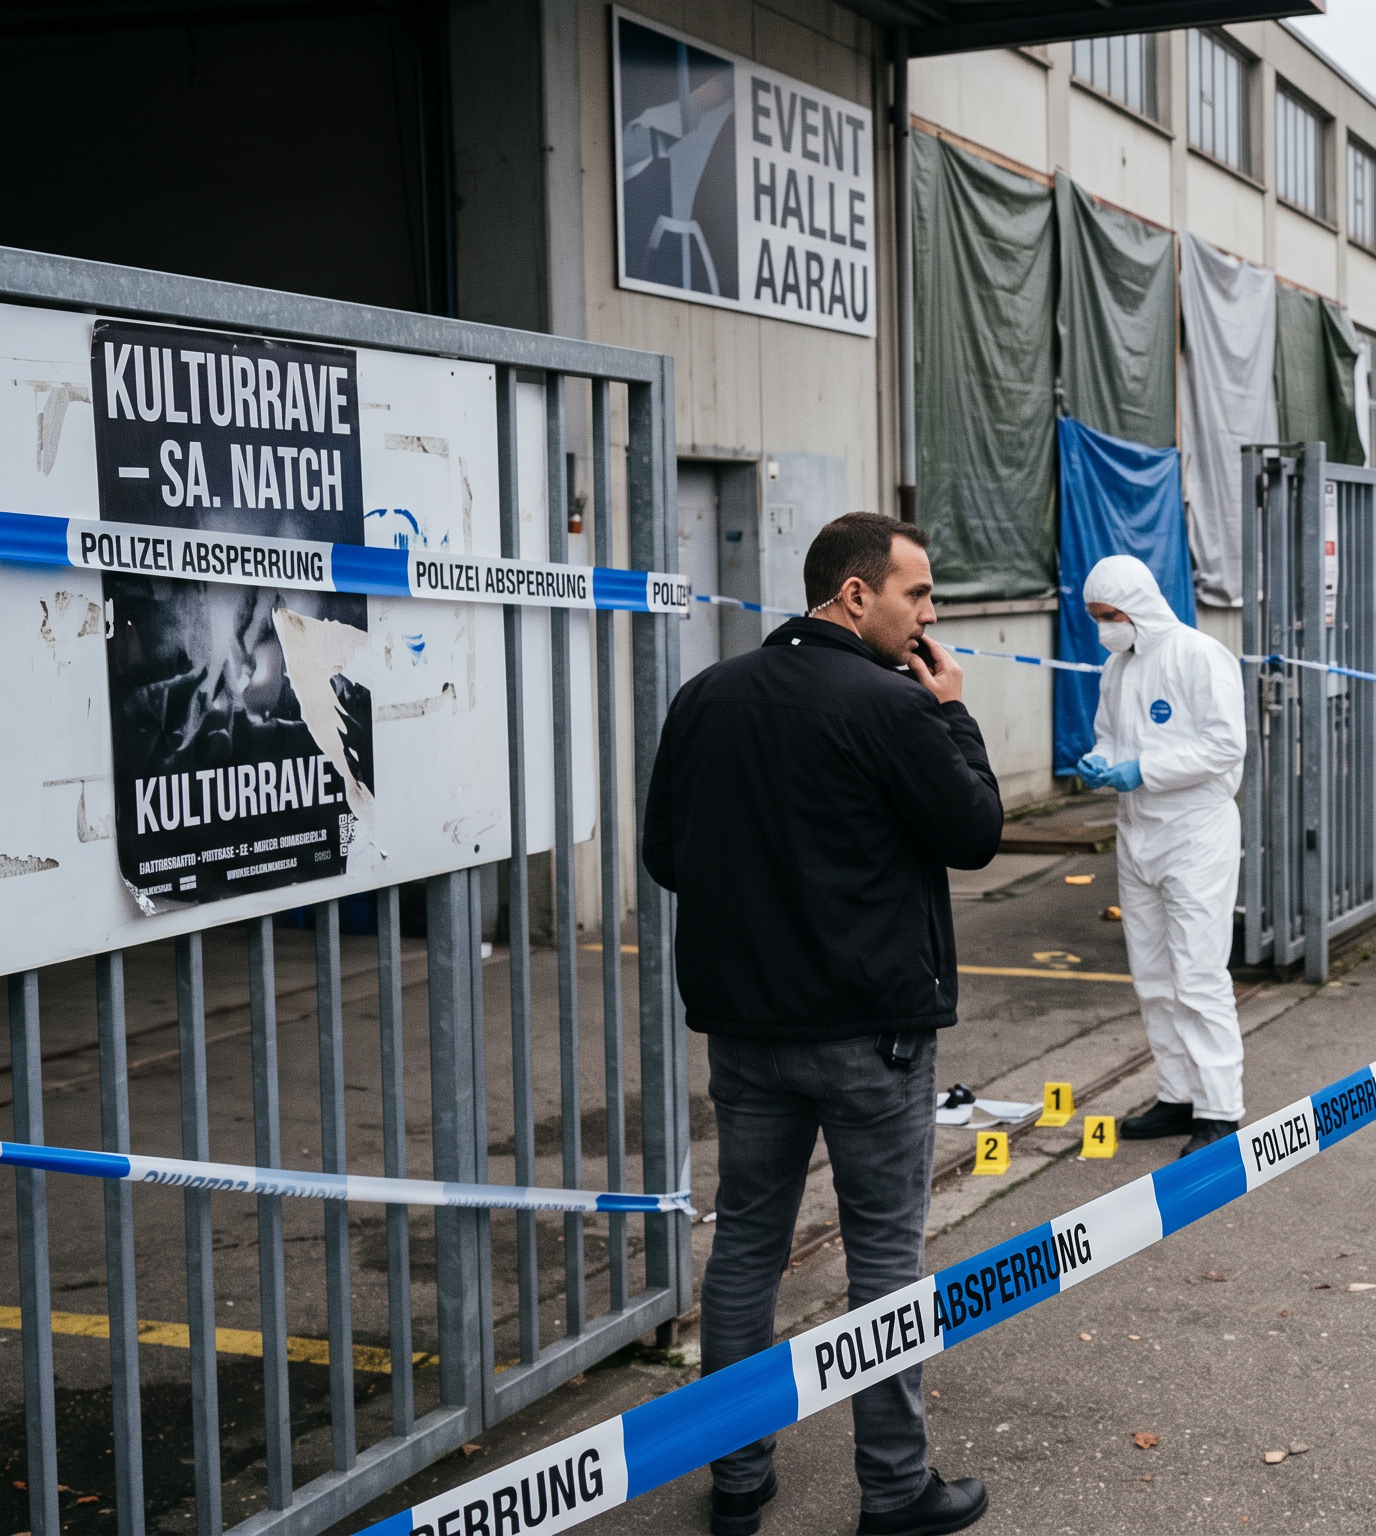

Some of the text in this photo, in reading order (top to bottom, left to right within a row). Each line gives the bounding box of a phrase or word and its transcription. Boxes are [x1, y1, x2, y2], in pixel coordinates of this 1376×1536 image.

[751, 75, 865, 177] EVENT
[753, 157, 867, 251] HALLE
[754, 238, 868, 323] AARAU
[104, 341, 350, 434] KULTURRAVE
[160, 439, 221, 507] SA.
[230, 443, 343, 511] NATCH
[81, 532, 324, 582] POLIZEI ABSPERRUNG
[416, 561, 586, 600] POLIZEI ABSPERRUNG
[1051, 1088, 1060, 1110] 1
[984, 1138, 998, 1160] 2
[1091, 1122, 1105, 1143] 4
[1251, 1113, 1310, 1172] POLIZEI
[814, 1222, 1092, 1391] POLIZEI ABSPERRUNG
